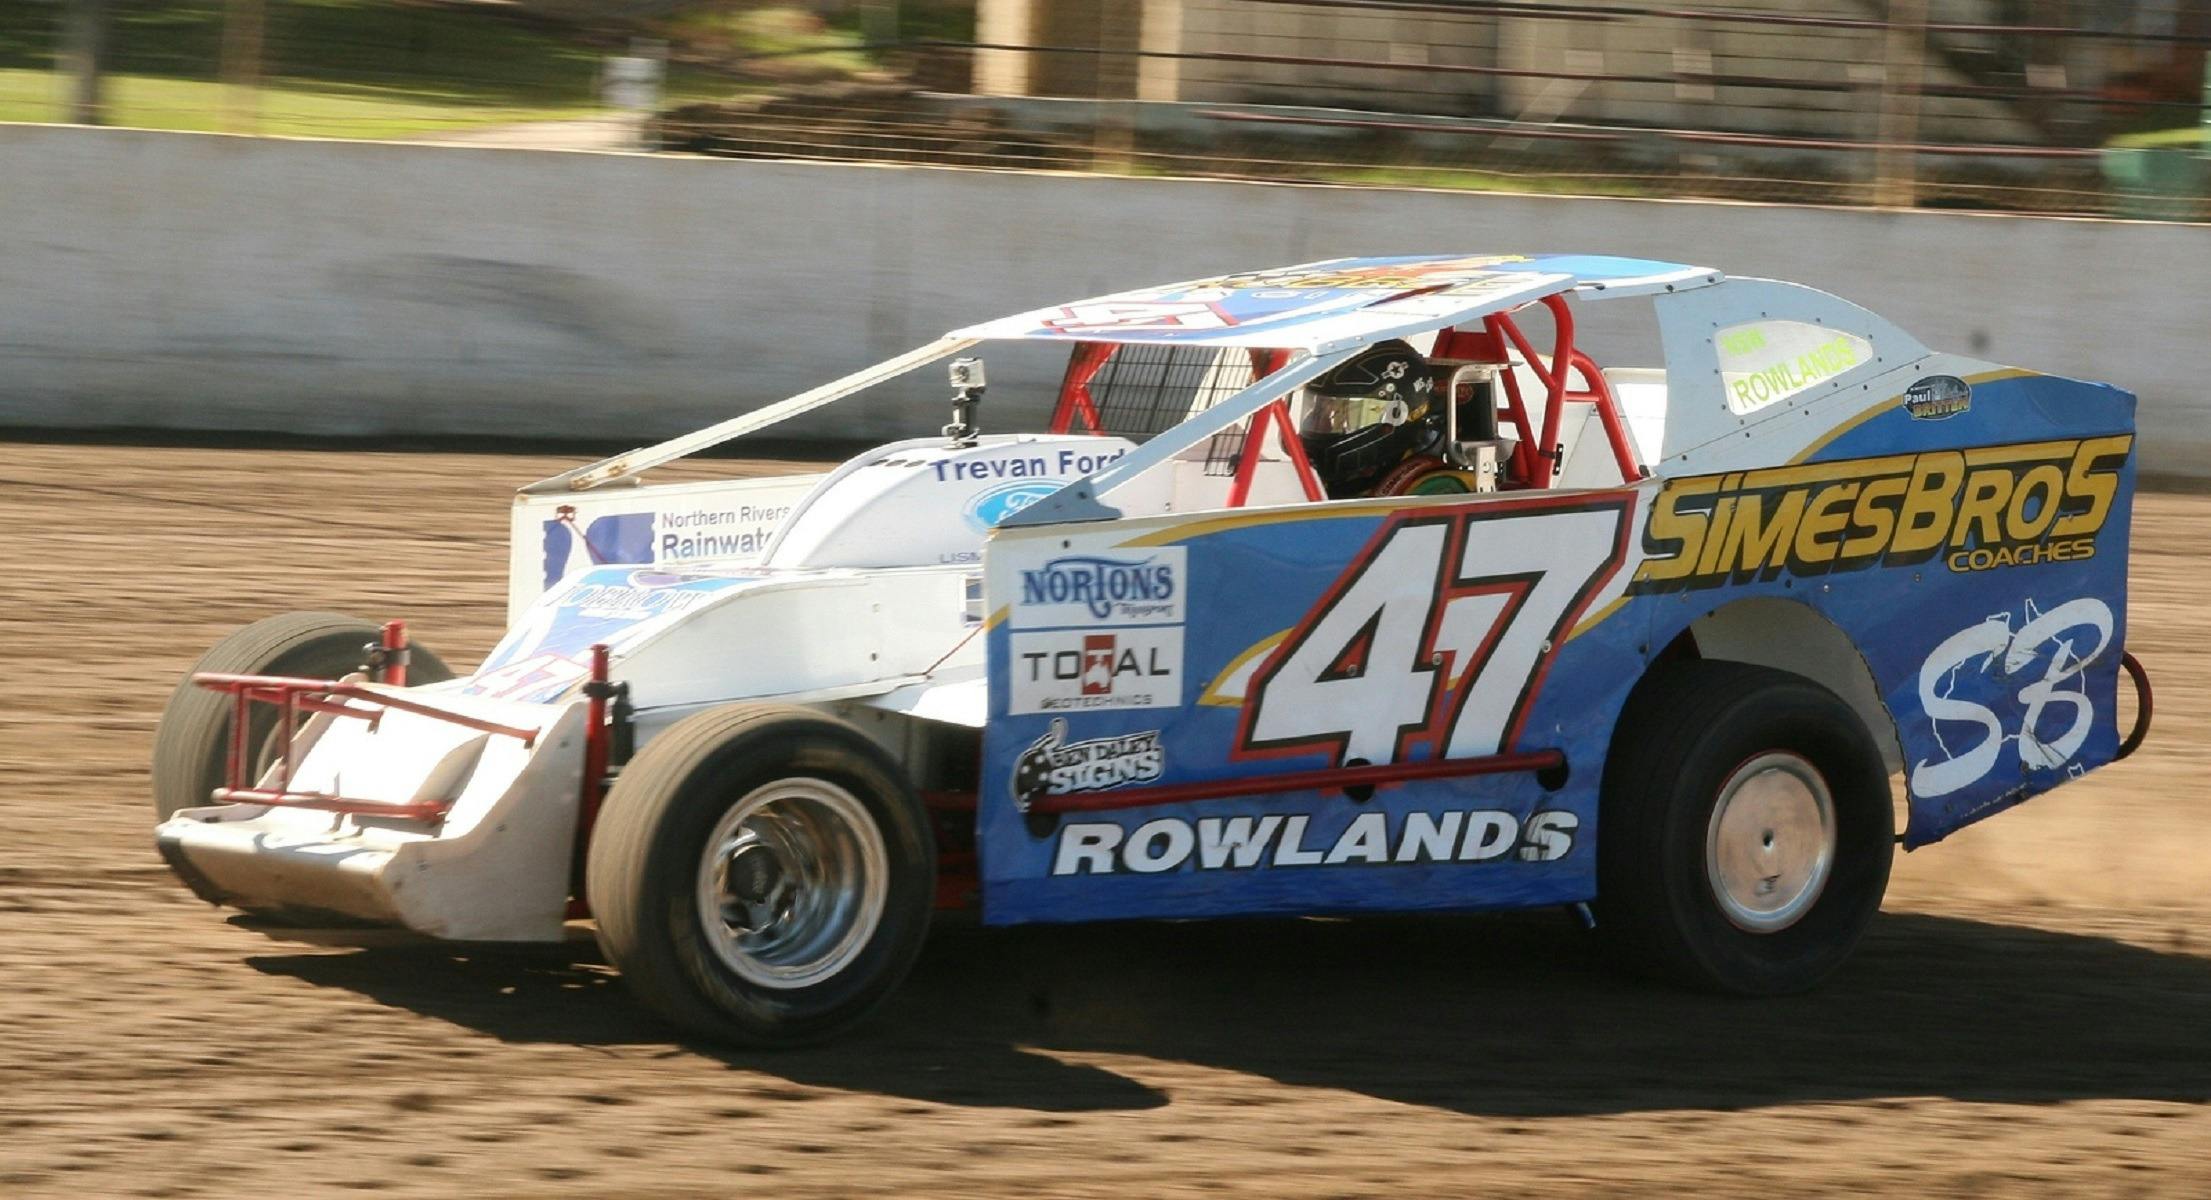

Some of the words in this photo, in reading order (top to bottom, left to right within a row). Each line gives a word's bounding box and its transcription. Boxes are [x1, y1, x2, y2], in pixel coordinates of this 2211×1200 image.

[1732, 337, 1856, 409] ROWLANDS
[1904, 389, 1931, 406] Paul
[930, 457, 1046, 482] Trevan
[662, 510, 735, 529] Northern
[1947, 538, 2096, 573] COACHES
[1019, 556, 1175, 619] NORTONS
[1236, 494, 1634, 774] 47
[1022, 646, 1170, 690] TOTAL
[1911, 598, 2114, 799] SB
[1047, 751, 1161, 795] SIGNS
[1050, 749, 1091, 769] BEN
[1053, 810, 1580, 877] ROWLANDS
